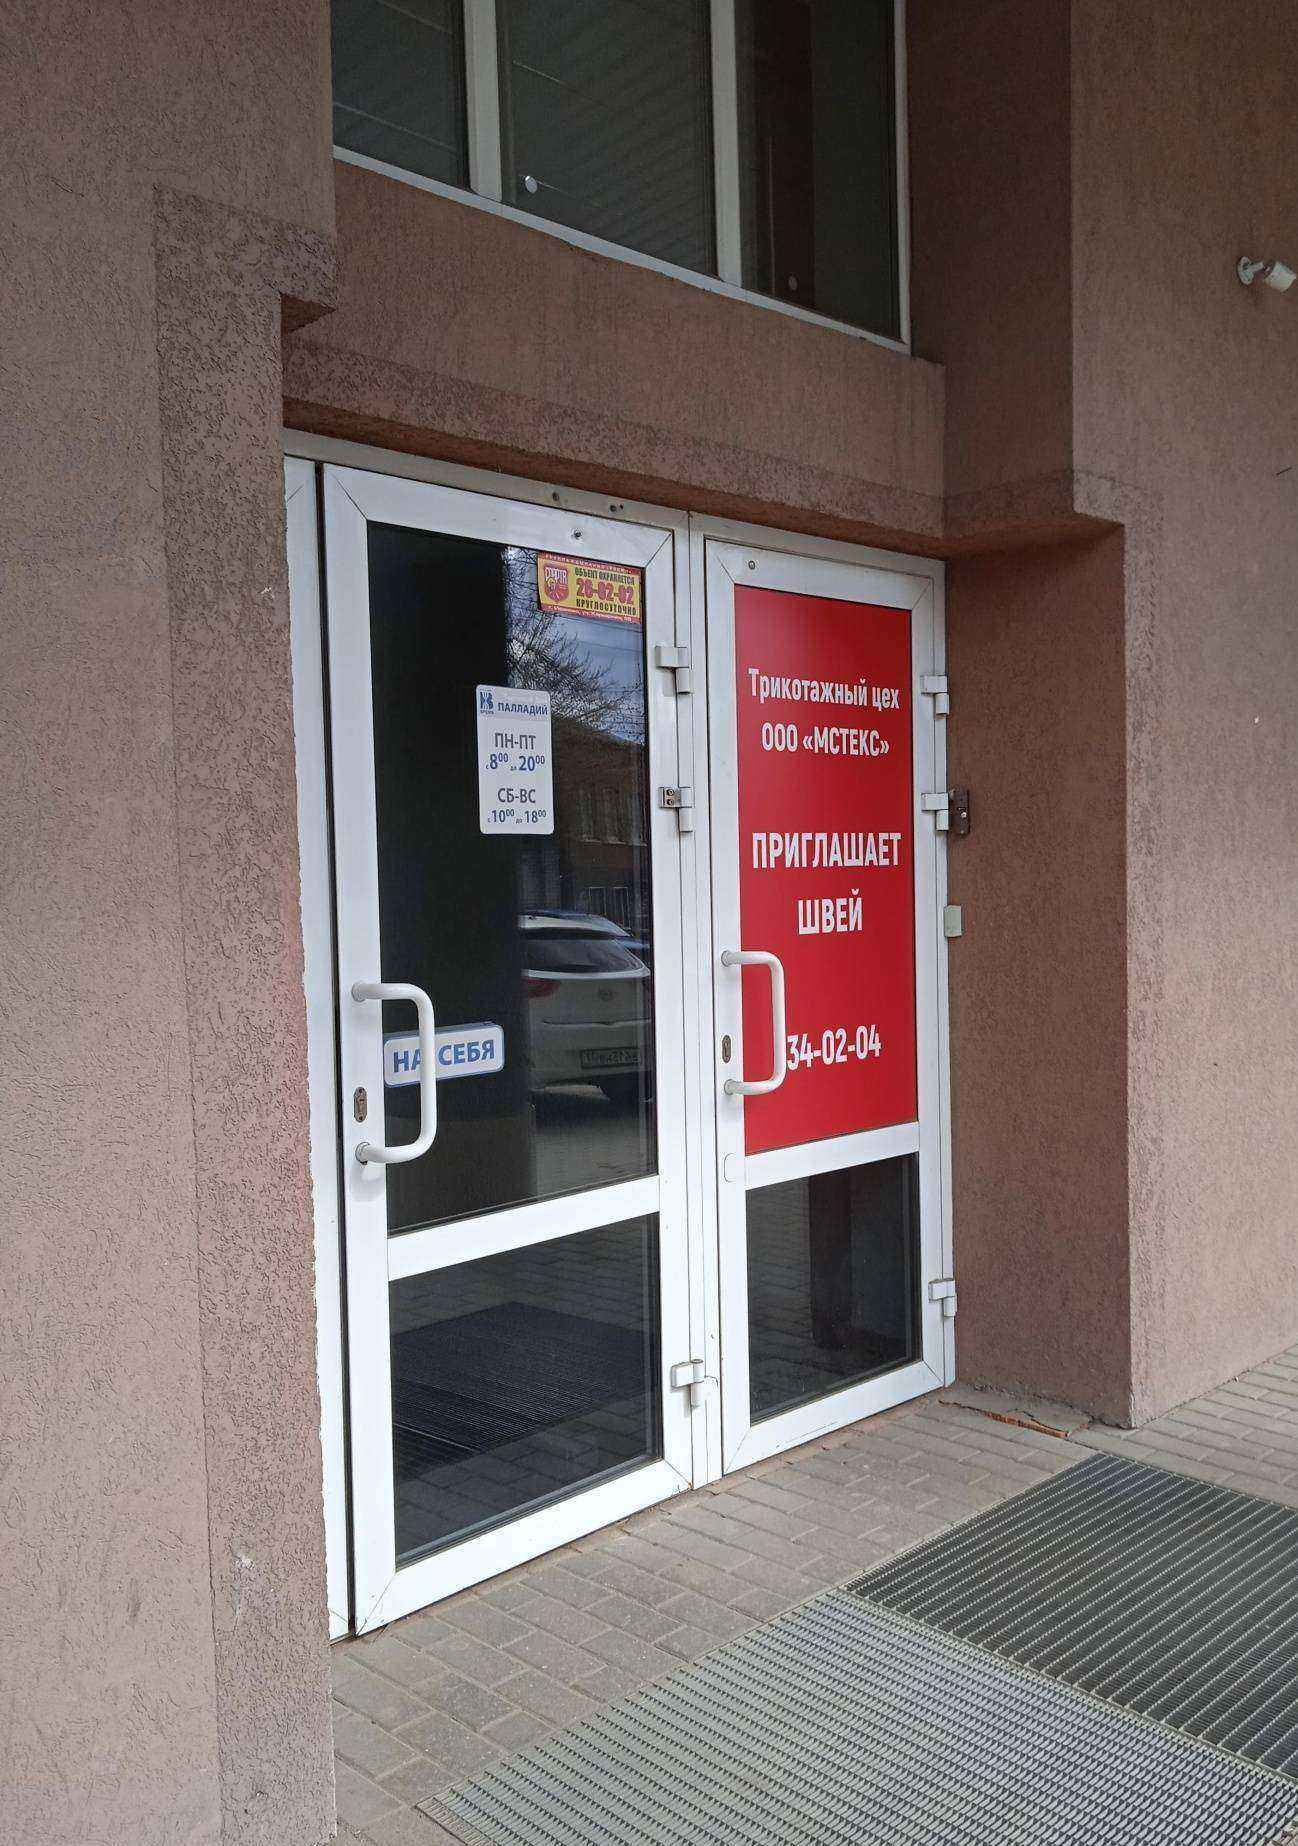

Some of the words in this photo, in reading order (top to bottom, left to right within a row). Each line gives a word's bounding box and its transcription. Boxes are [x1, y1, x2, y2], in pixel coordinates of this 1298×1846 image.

[576, 598, 637, 616] КРУГЛОСУТОЧНО
[748, 667, 867, 707] Трикотажный
[872, 686, 900, 711] цех
[497, 702, 548, 716] ПАЛЛАДИЙ
[494, 732, 537, 750] ПН-ПТ
[761, 722, 798, 752] ООО
[802, 726, 890, 757] «МСТЕКС»
[497, 787, 536, 804] СБ-ВС
[752, 832, 902, 869] ПРИГЛАШАЕТ
[798, 888, 864, 936] ШВЕЙ
[437, 1039, 495, 1067] СЕБЯ
[786, 1024, 882, 1071] 34-02-04
